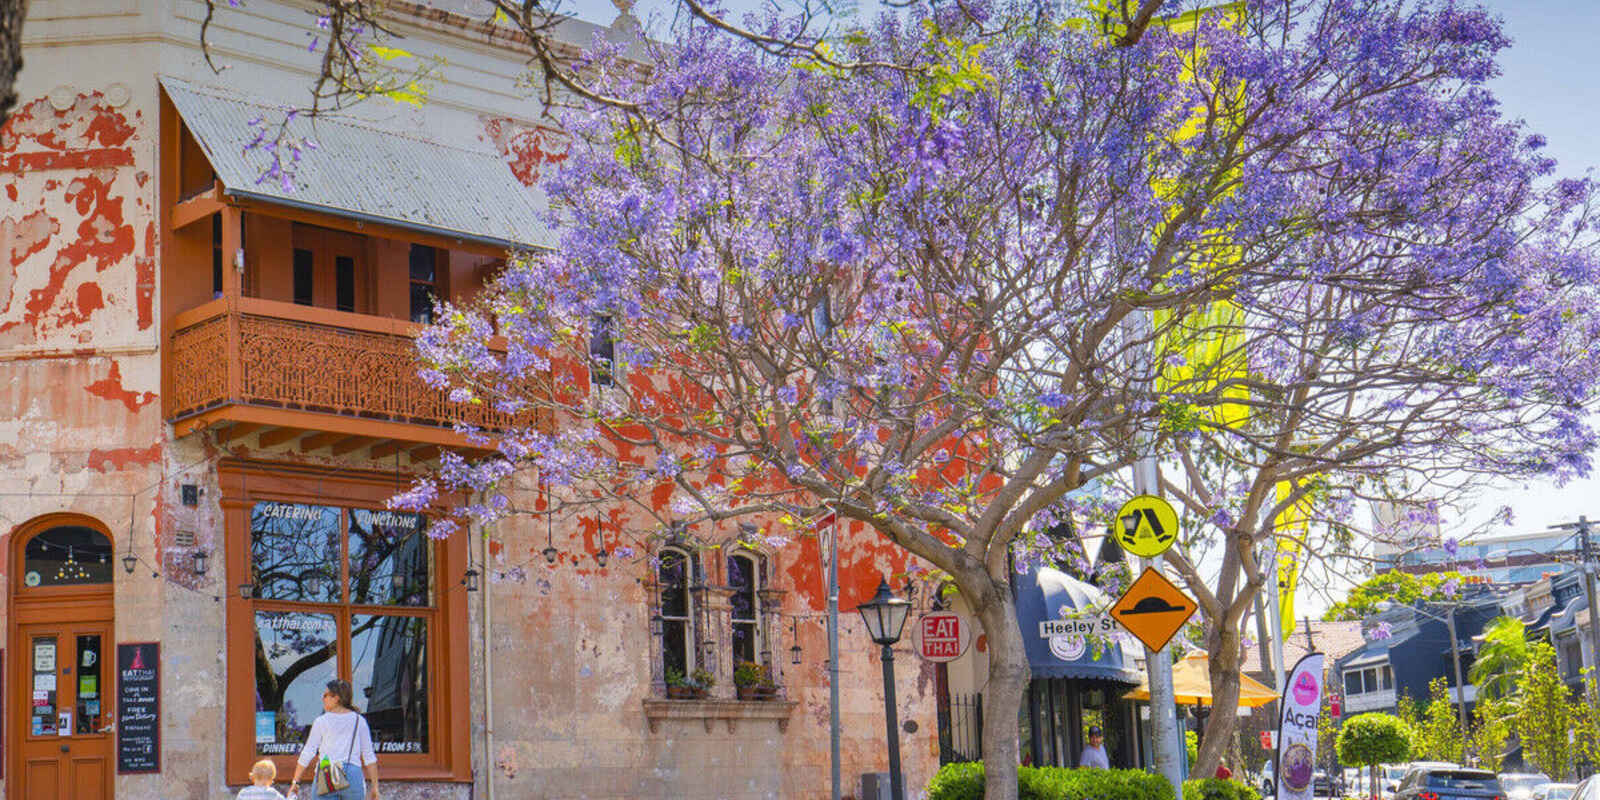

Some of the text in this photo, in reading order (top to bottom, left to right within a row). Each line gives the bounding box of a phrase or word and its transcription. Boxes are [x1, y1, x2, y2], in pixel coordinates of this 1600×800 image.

[264, 503, 322, 520] CATERING
[357, 511, 416, 529] FUNCTIONS
[924, 618, 957, 637] EAT
[1044, 618, 1117, 634] Heeley St
[925, 641, 958, 655] THAI
[263, 743, 297, 753] DINNER
